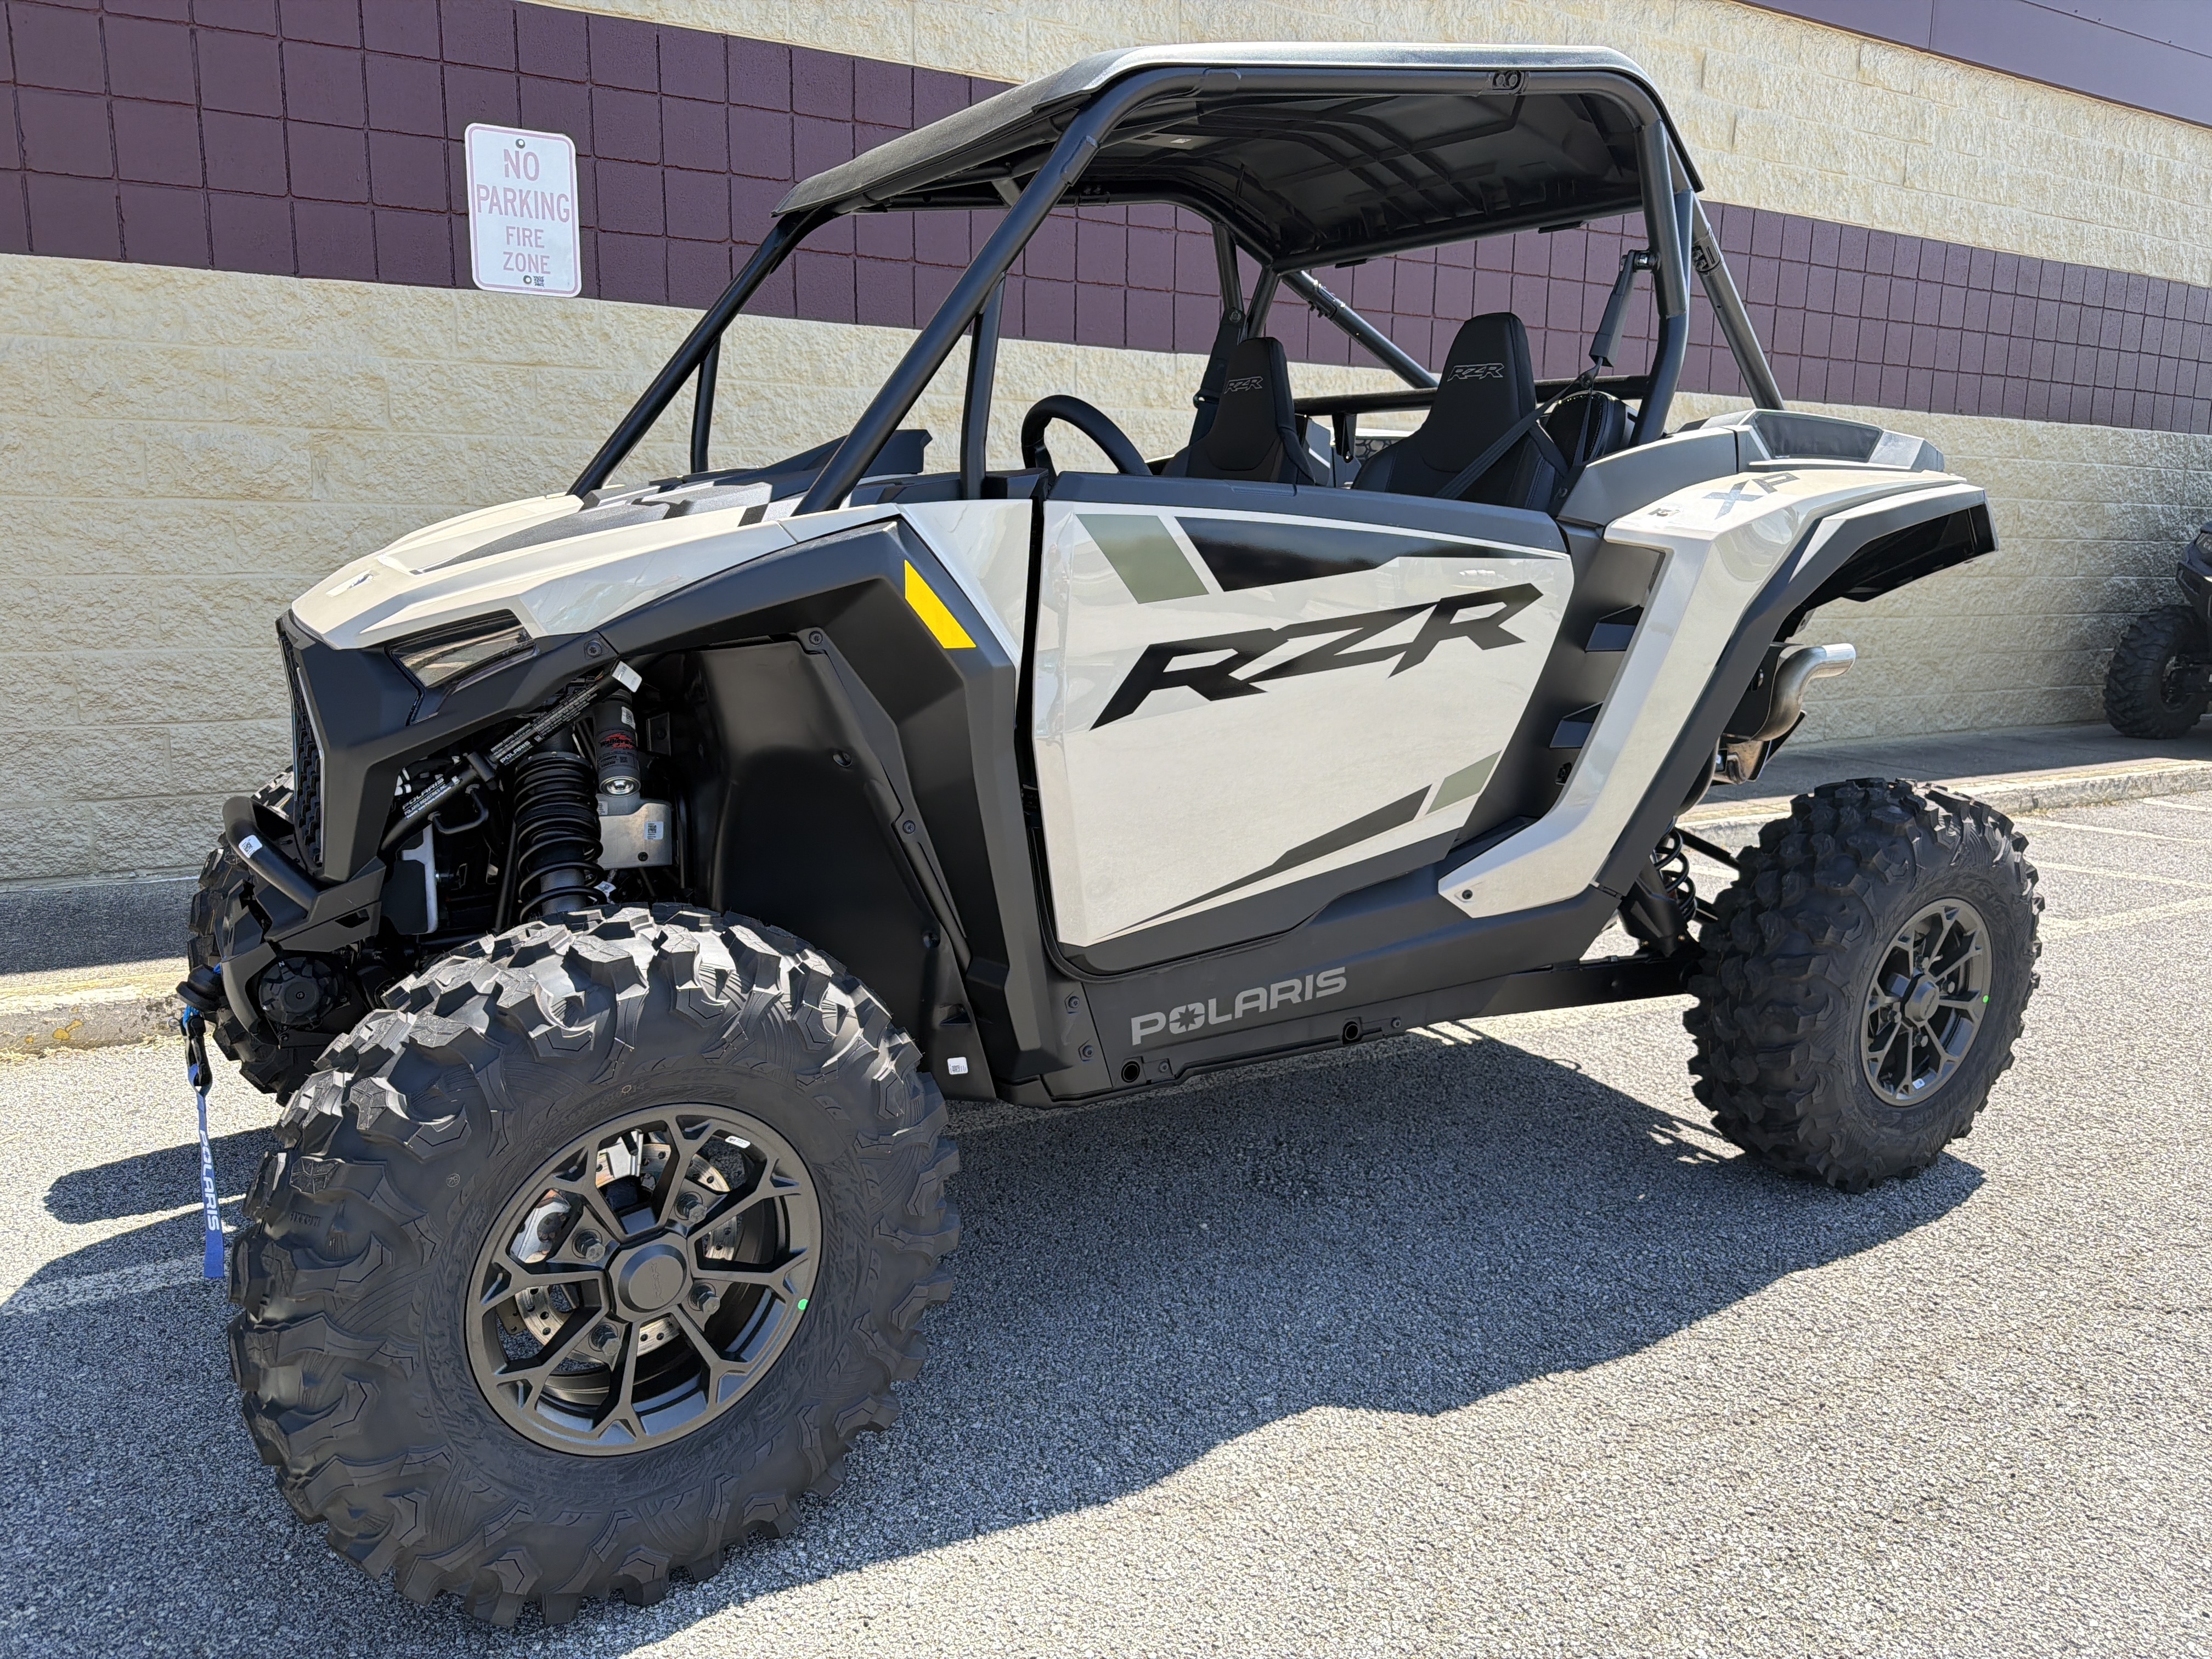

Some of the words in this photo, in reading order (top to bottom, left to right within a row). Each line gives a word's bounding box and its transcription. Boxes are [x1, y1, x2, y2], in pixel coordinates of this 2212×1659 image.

[504, 149, 540, 181] NO
[476, 184, 570, 222] PARKING
[506, 226, 545, 248] FIRE
[503, 251, 551, 274] ZONE
[1223, 376, 1263, 394] RZR
[1447, 363, 1505, 382] RZR
[1701, 472, 1801, 521] XP
[1088, 582, 1544, 731] RZR
[500, 740, 531, 764] POLARIS
[402, 778, 445, 810] POLARIS
[1131, 967, 1347, 1046] POLARIS
[199, 1129, 220, 1231] POLARIS
